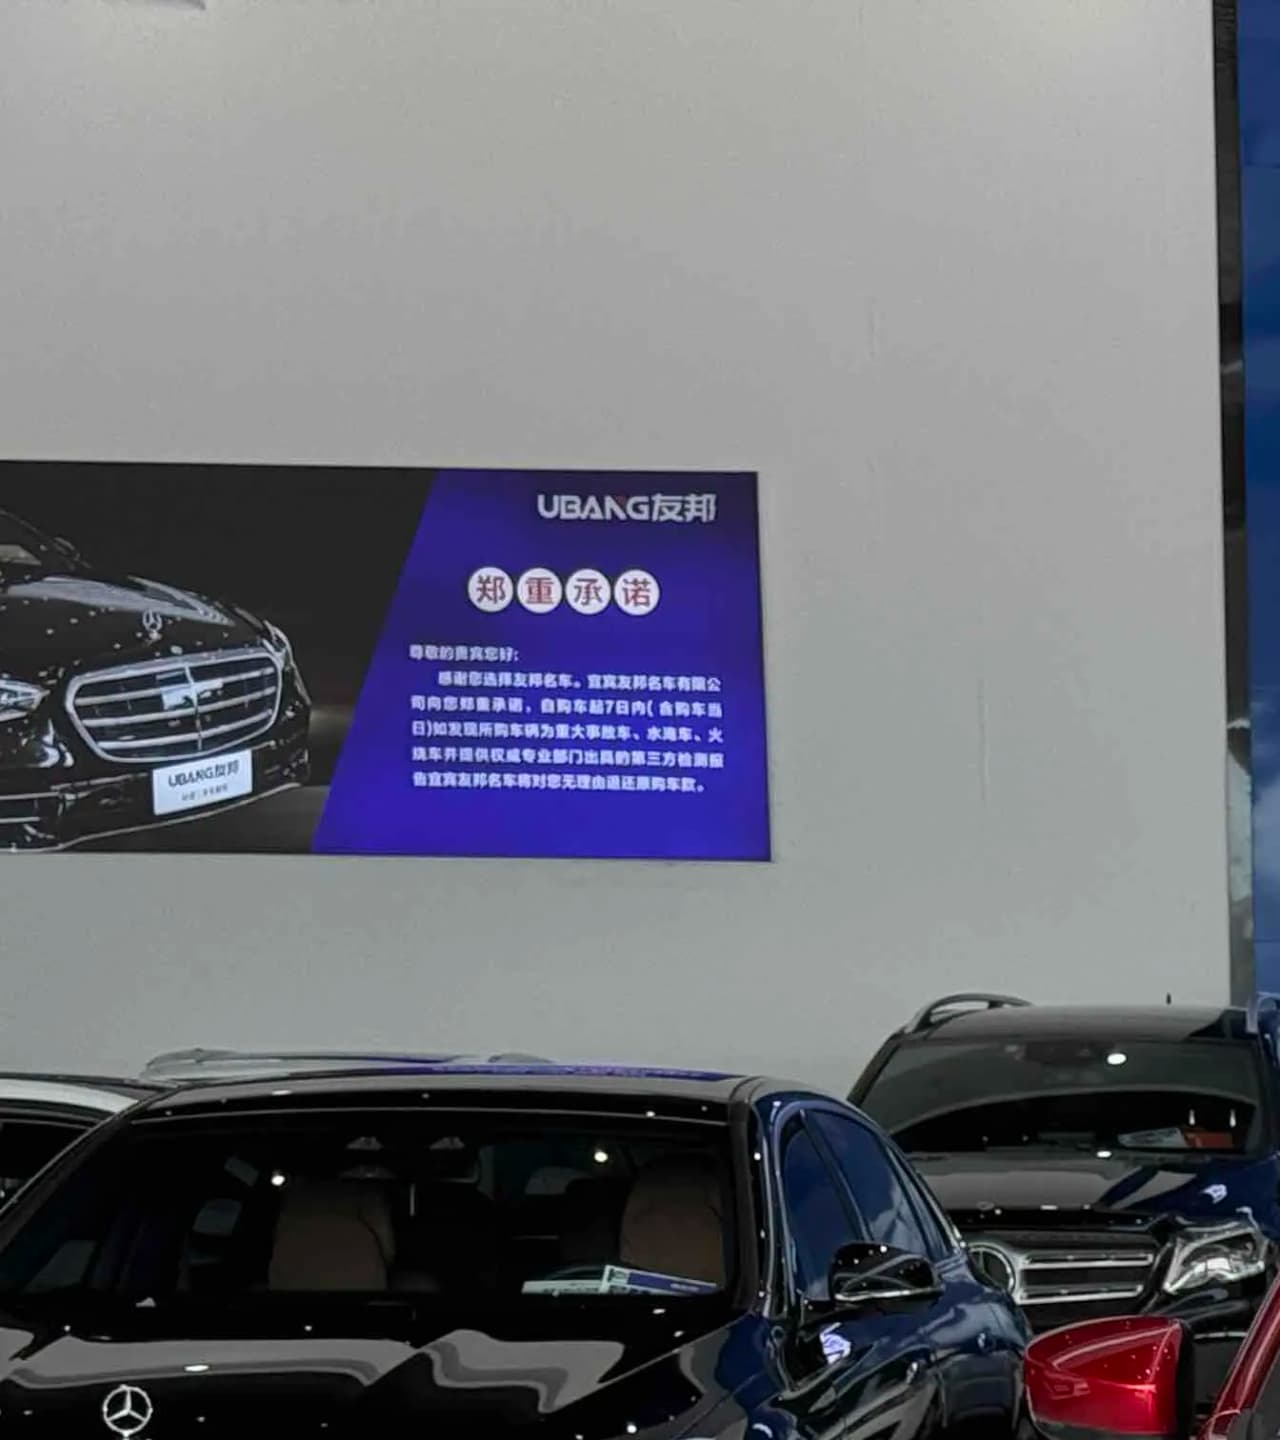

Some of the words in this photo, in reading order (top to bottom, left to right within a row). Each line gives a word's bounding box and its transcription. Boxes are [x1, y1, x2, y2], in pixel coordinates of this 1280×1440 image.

[537, 493, 716, 522] UBANG友邦
[476, 574, 651, 607] 郑重承诺
